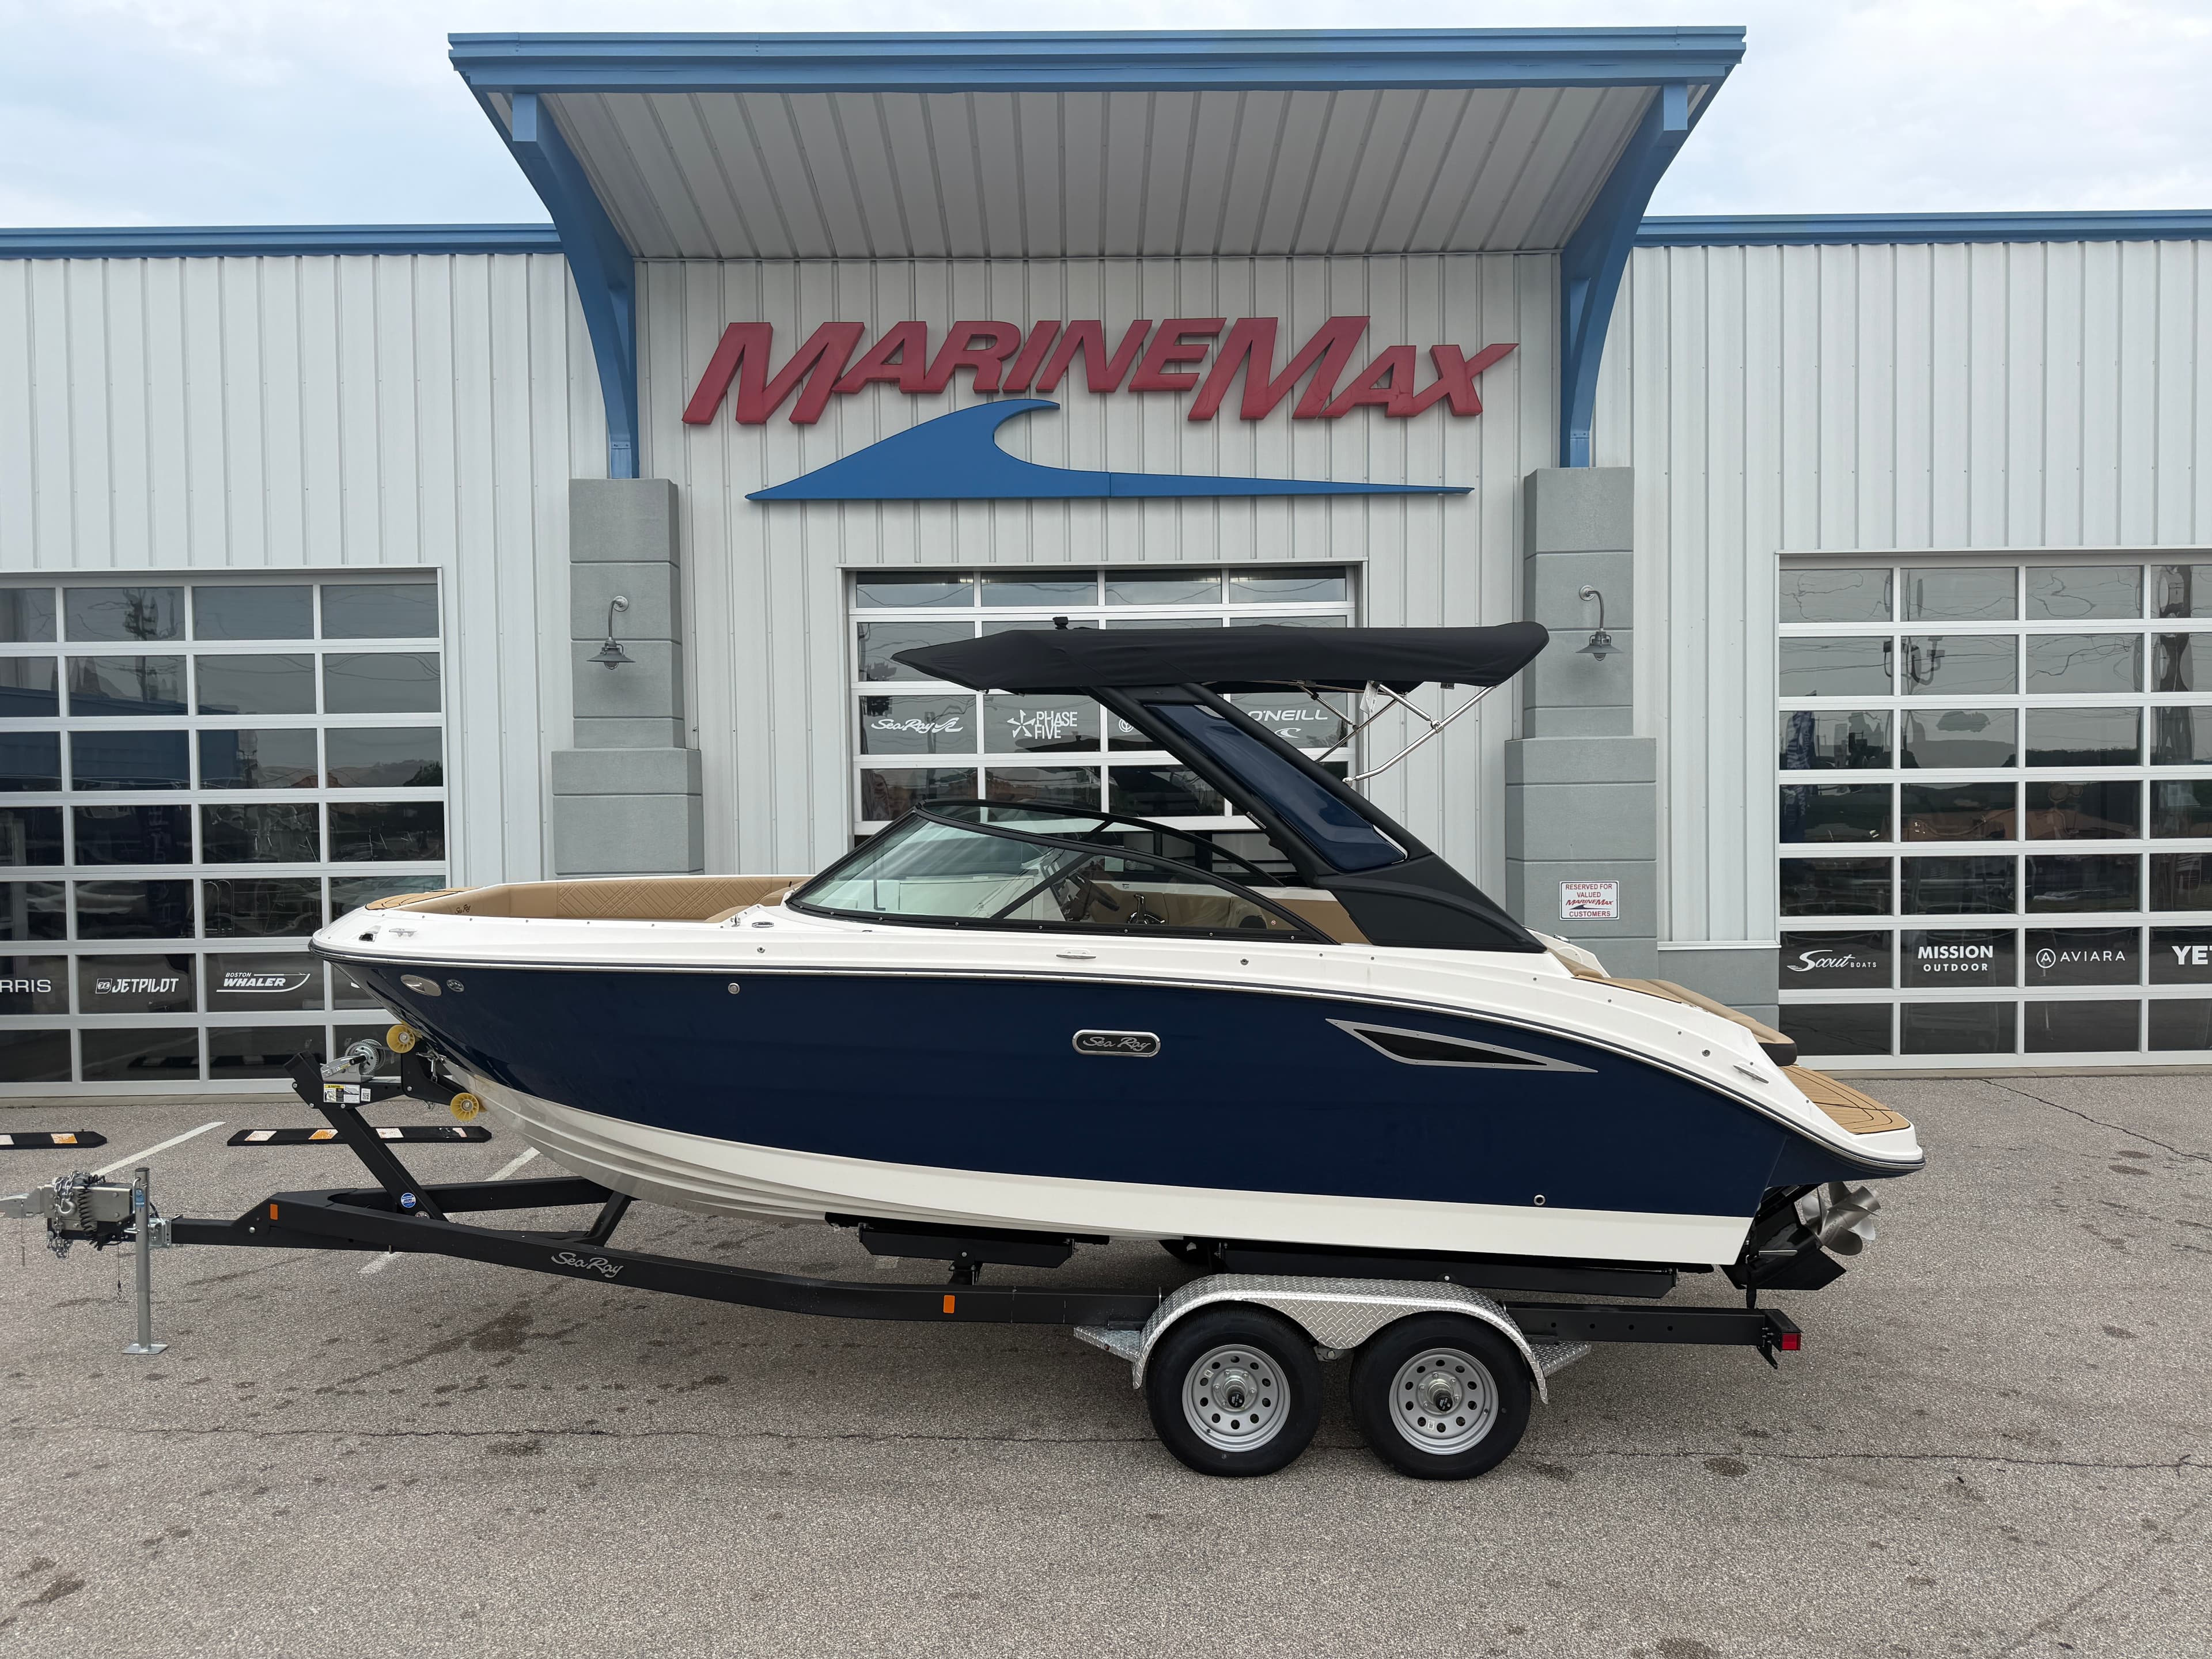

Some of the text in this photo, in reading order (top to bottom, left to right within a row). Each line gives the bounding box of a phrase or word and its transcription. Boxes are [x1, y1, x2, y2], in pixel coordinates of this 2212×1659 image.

[1036, 711, 1078, 726] PHASE
[1248, 709, 1328, 721] O'NEILL
[871, 719, 935, 734] Sea Ray
[1035, 724, 1061, 740] FIVE
[1918, 945, 1993, 959] MISSION
[2060, 950, 2126, 962] AVIARA
[2171, 945, 2212, 965] YE
[1787, 949, 1855, 972] Scout
[1923, 963, 1988, 972] OUTDOOR
[112, 978, 179, 993] JETPILOT
[224, 978, 286, 987] WHALER
[1082, 1036, 1152, 1052] Sea Ray
[551, 1252, 624, 1278] Sea Ray
